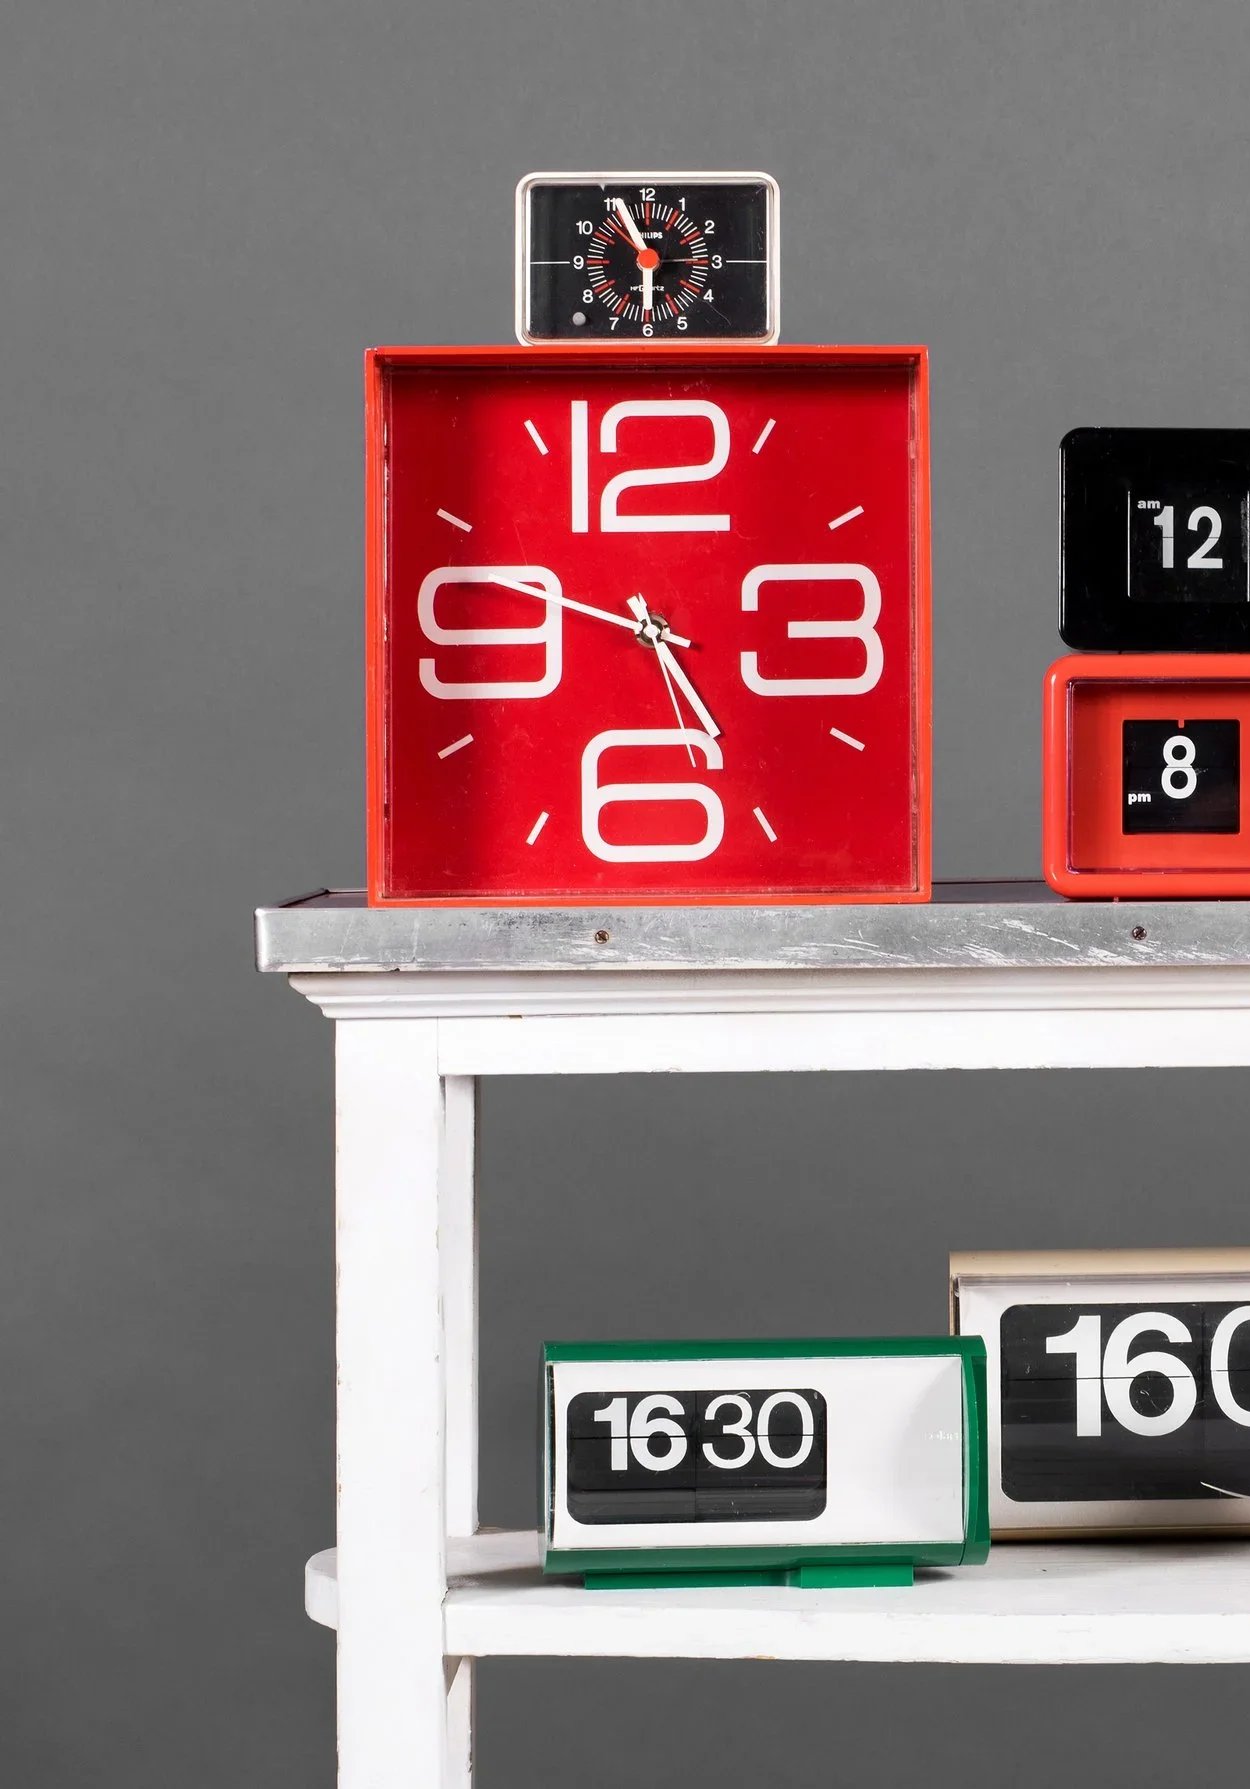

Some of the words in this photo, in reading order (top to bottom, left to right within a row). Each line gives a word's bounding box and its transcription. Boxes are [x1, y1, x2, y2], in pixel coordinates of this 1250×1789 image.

[639, 188, 656, 201] 12
[603, 197, 616, 212] 11
[678, 197, 686, 212] 1
[576, 220, 593, 234] 10
[704, 219, 715, 234] 2
[638, 231, 663, 239] HILIPS
[573, 255, 585, 270] 9
[711, 254, 723, 270] 3
[582, 289, 594, 304] 8
[703, 289, 714, 303] 4
[609, 317, 620, 331] 7
[642, 324, 654, 338] 6
[676, 316, 688, 331] 5
[571, 400, 731, 533] 12
[1137, 500, 1161, 509] am
[1153, 505, 1223, 569] 12
[417, 565, 563, 700] 9
[740, 563, 884, 697] 3
[1161, 735, 1198, 799] 8
[581, 728, 724, 863] 6
[1127, 793, 1152, 806] pm
[1045, 1311, 1198, 1437] 16
[593, 1394, 688, 1471] 16
[702, 1391, 814, 1469] 30
